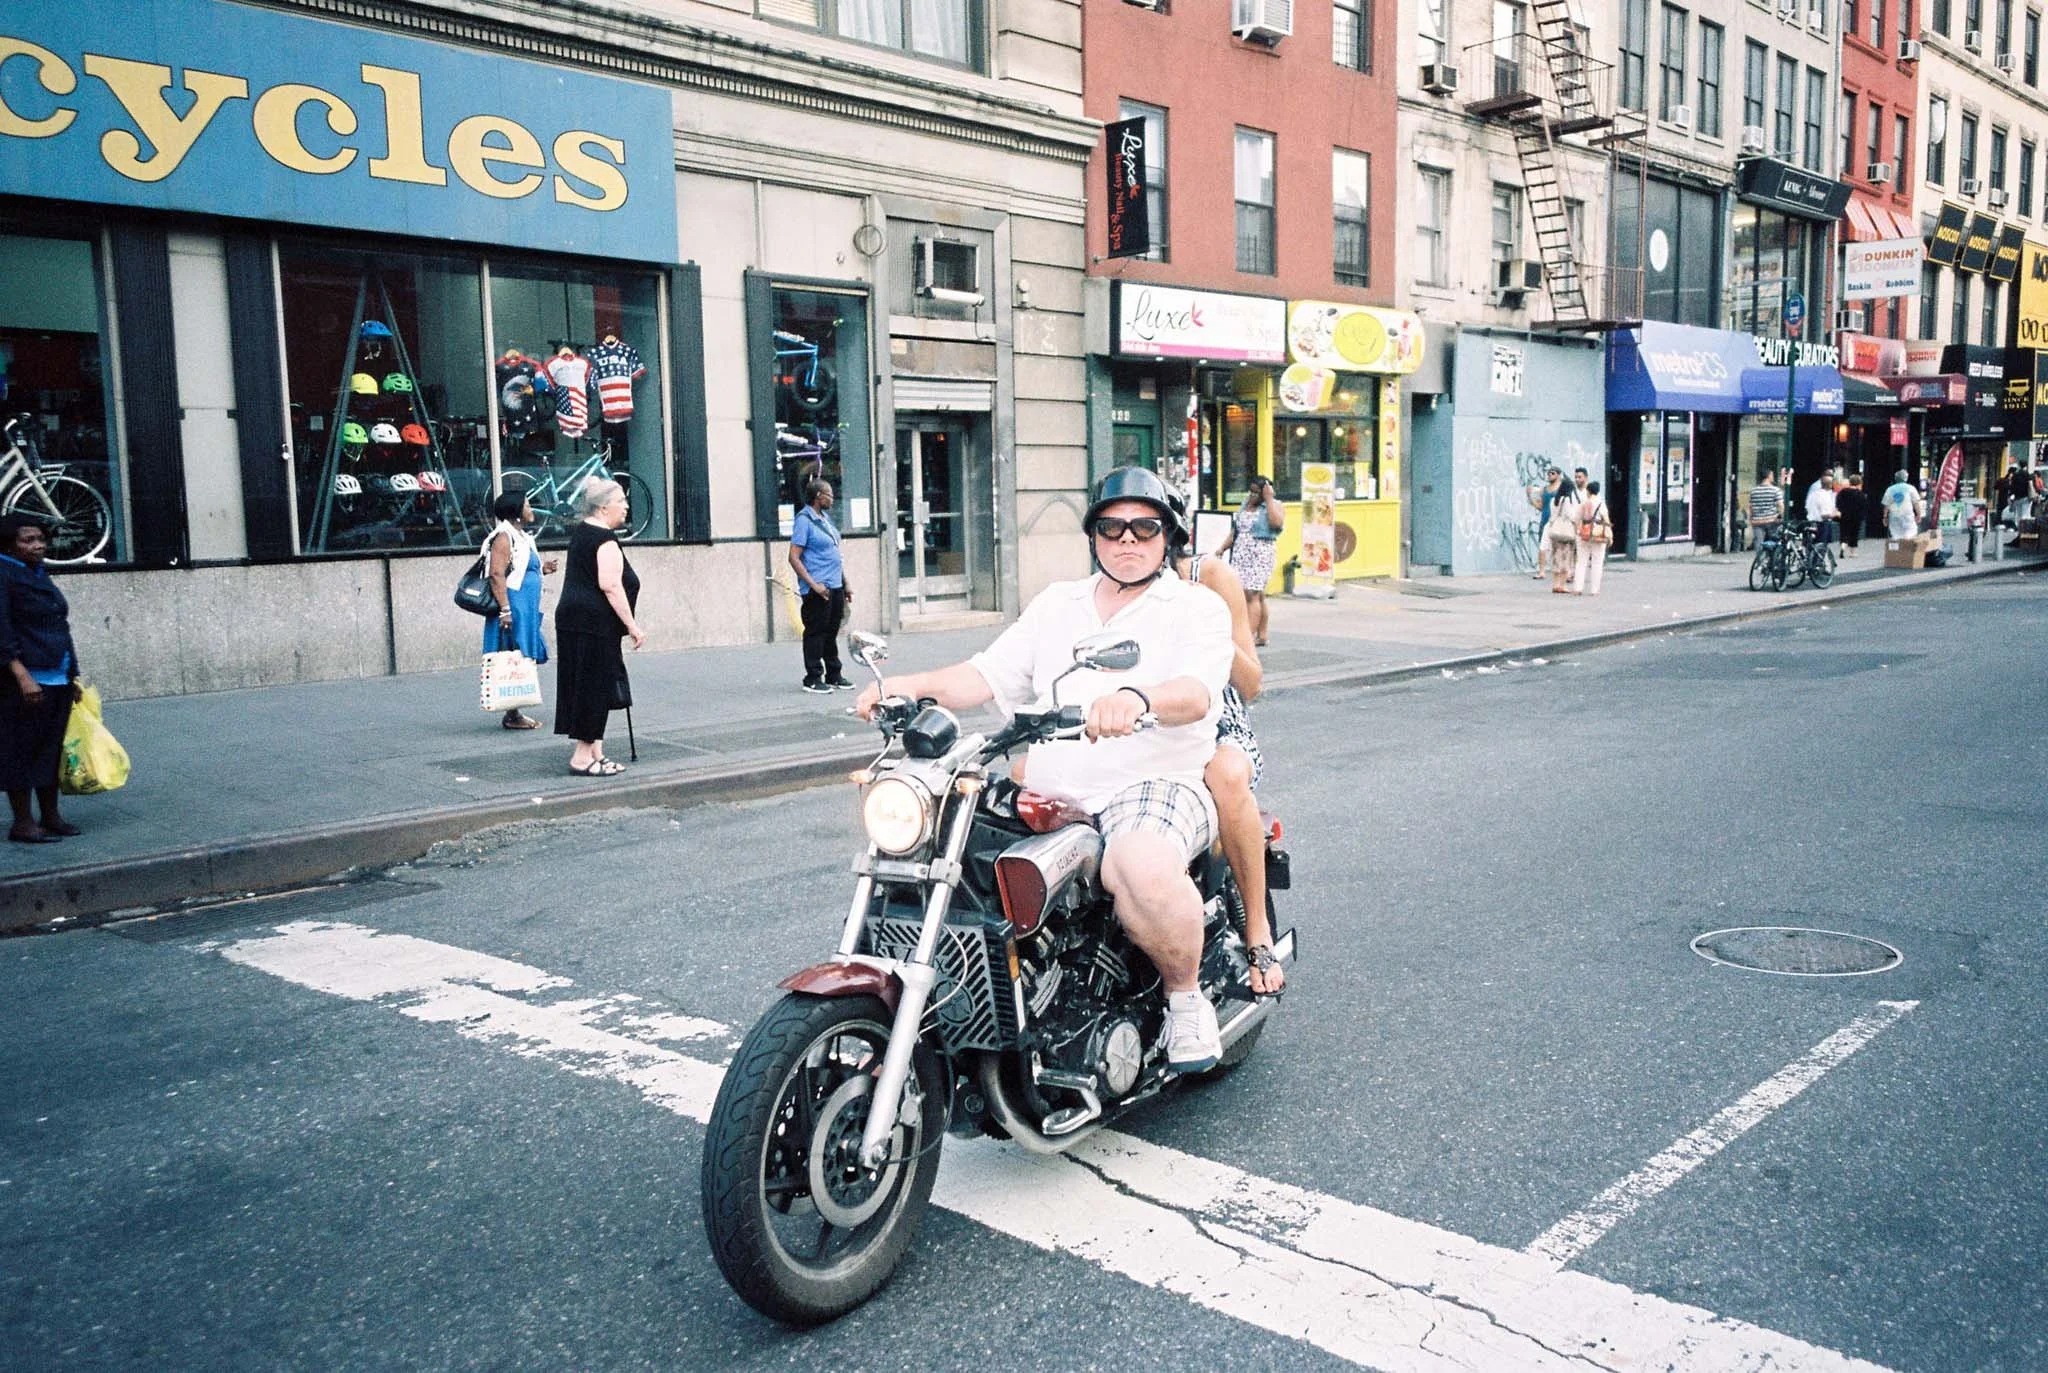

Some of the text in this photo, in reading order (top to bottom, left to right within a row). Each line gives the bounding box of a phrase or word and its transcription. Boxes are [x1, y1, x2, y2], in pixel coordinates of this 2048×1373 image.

[0, 36, 629, 212] cycles
[1115, 190, 1125, 215] Nail
[1110, 224, 1124, 250] Spa
[597, 355, 628, 366] USA
[1753, 336, 1791, 366] BEAUTY
